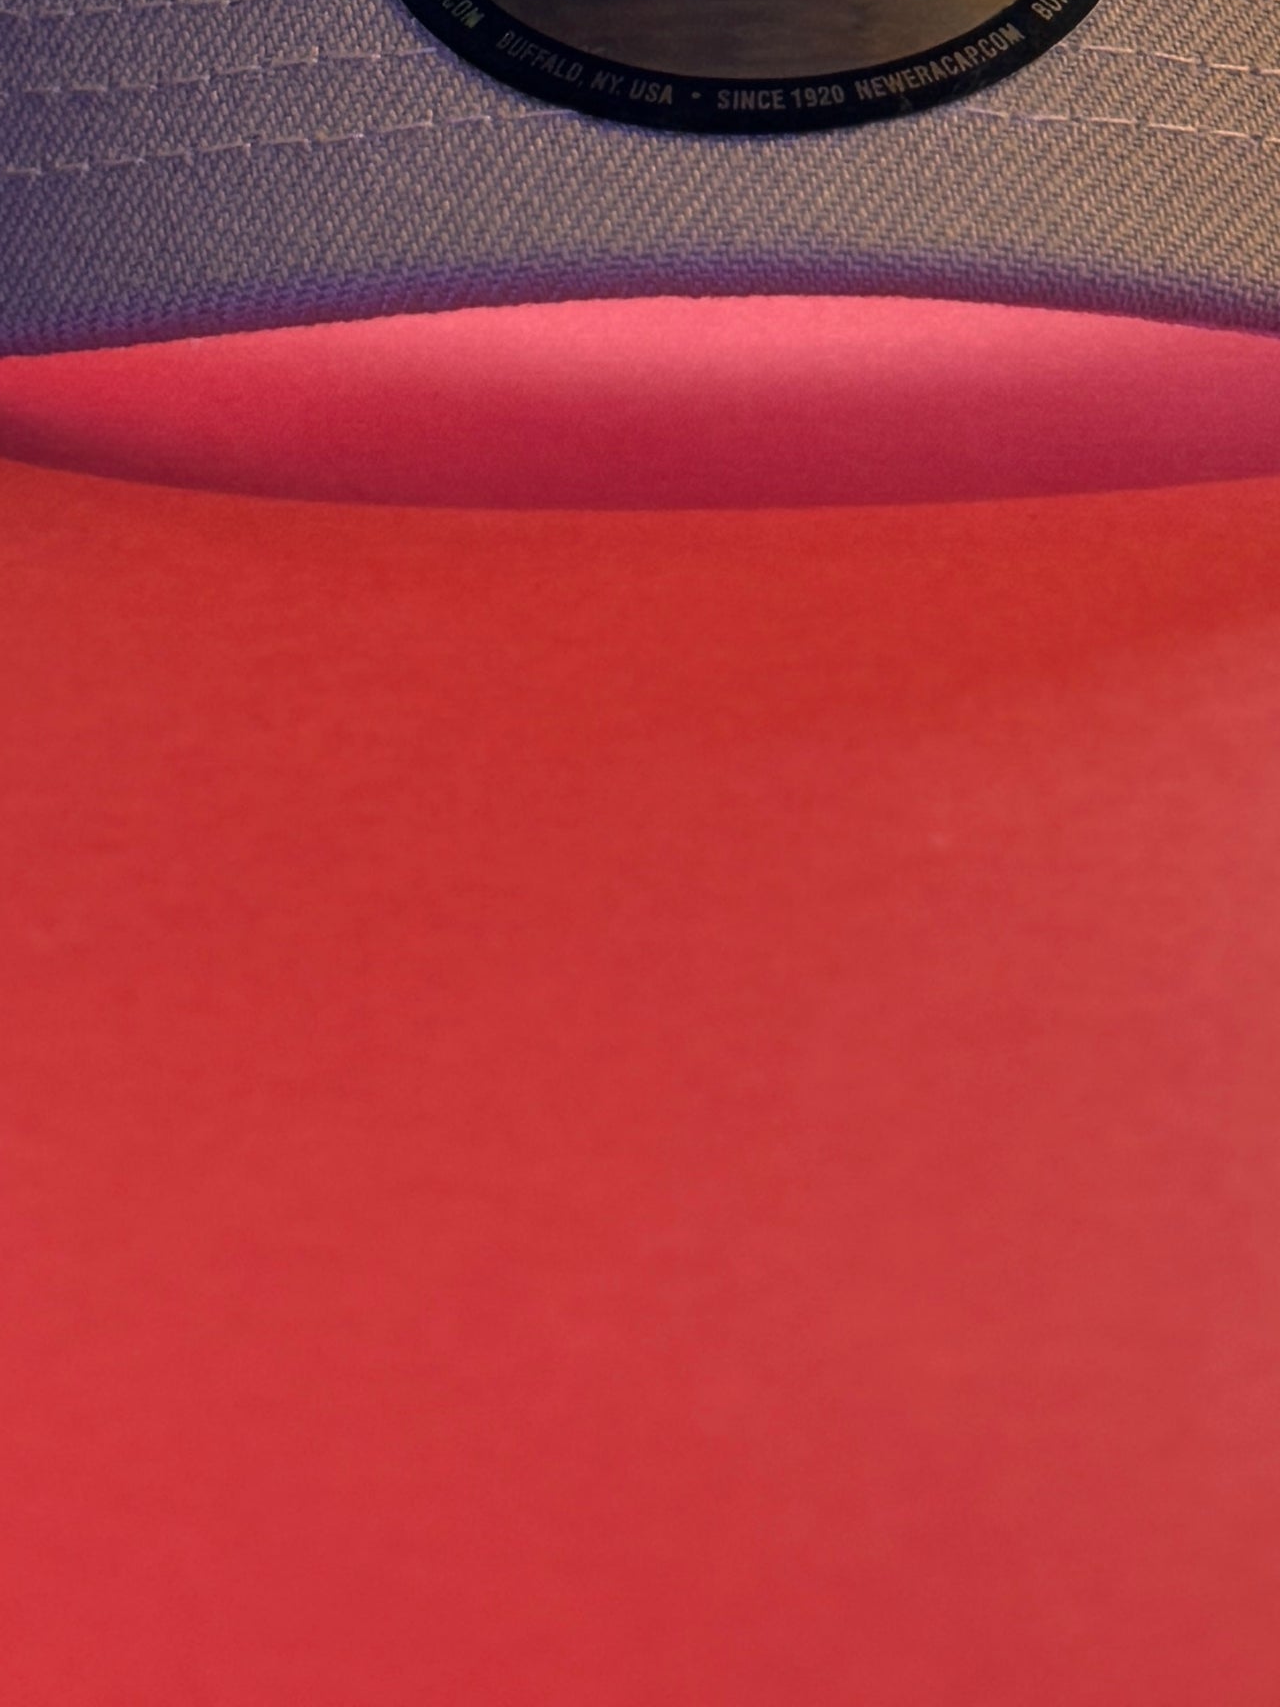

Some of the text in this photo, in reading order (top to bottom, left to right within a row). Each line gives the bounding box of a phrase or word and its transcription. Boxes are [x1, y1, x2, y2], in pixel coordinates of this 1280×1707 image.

[629, 79, 674, 106] USA
[716, 88, 787, 110] SINCE
[790, 84, 846, 109] 1920
[854, 22, 1026, 102] NEWERACAP.COM
